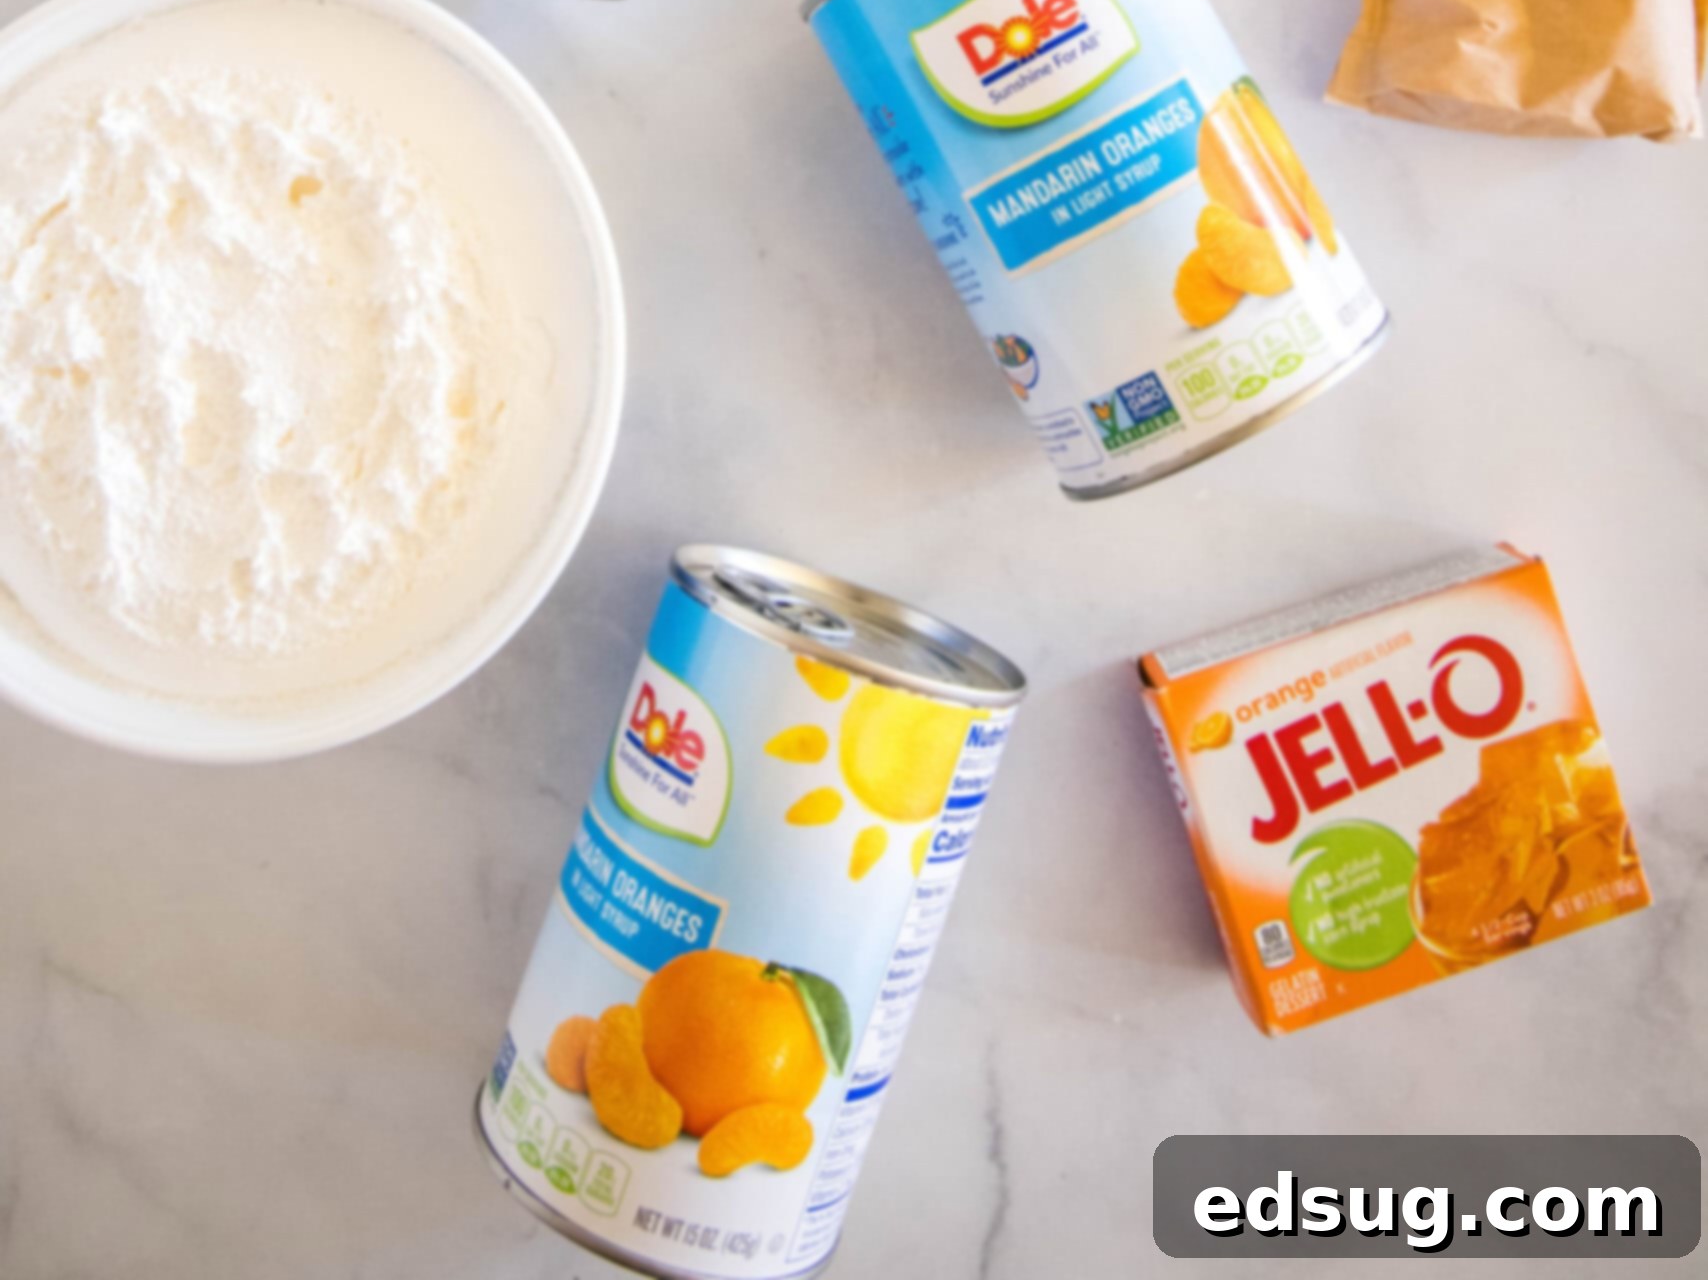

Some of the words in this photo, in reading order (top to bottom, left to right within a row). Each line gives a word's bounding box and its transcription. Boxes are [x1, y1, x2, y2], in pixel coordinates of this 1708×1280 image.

[988, 62, 1053, 105] Sunshine
[1051, 47, 1077, 69] For
[986, 150, 1102, 228] MANDARIN
[1100, 96, 1197, 166] ORANGES
[1050, 205, 1073, 227] IN
[1070, 180, 1114, 216] LIGHT
[1113, 152, 1162, 191] SYRUP
[1121, 376, 1156, 398] NON
[1128, 386, 1164, 412] GMO
[1182, 366, 1216, 397] 100
[1235, 669, 1327, 724] orange
[629, 681, 705, 772] Dole
[611, 869, 704, 945] ORANGES
[632, 1204, 663, 1236] NET
